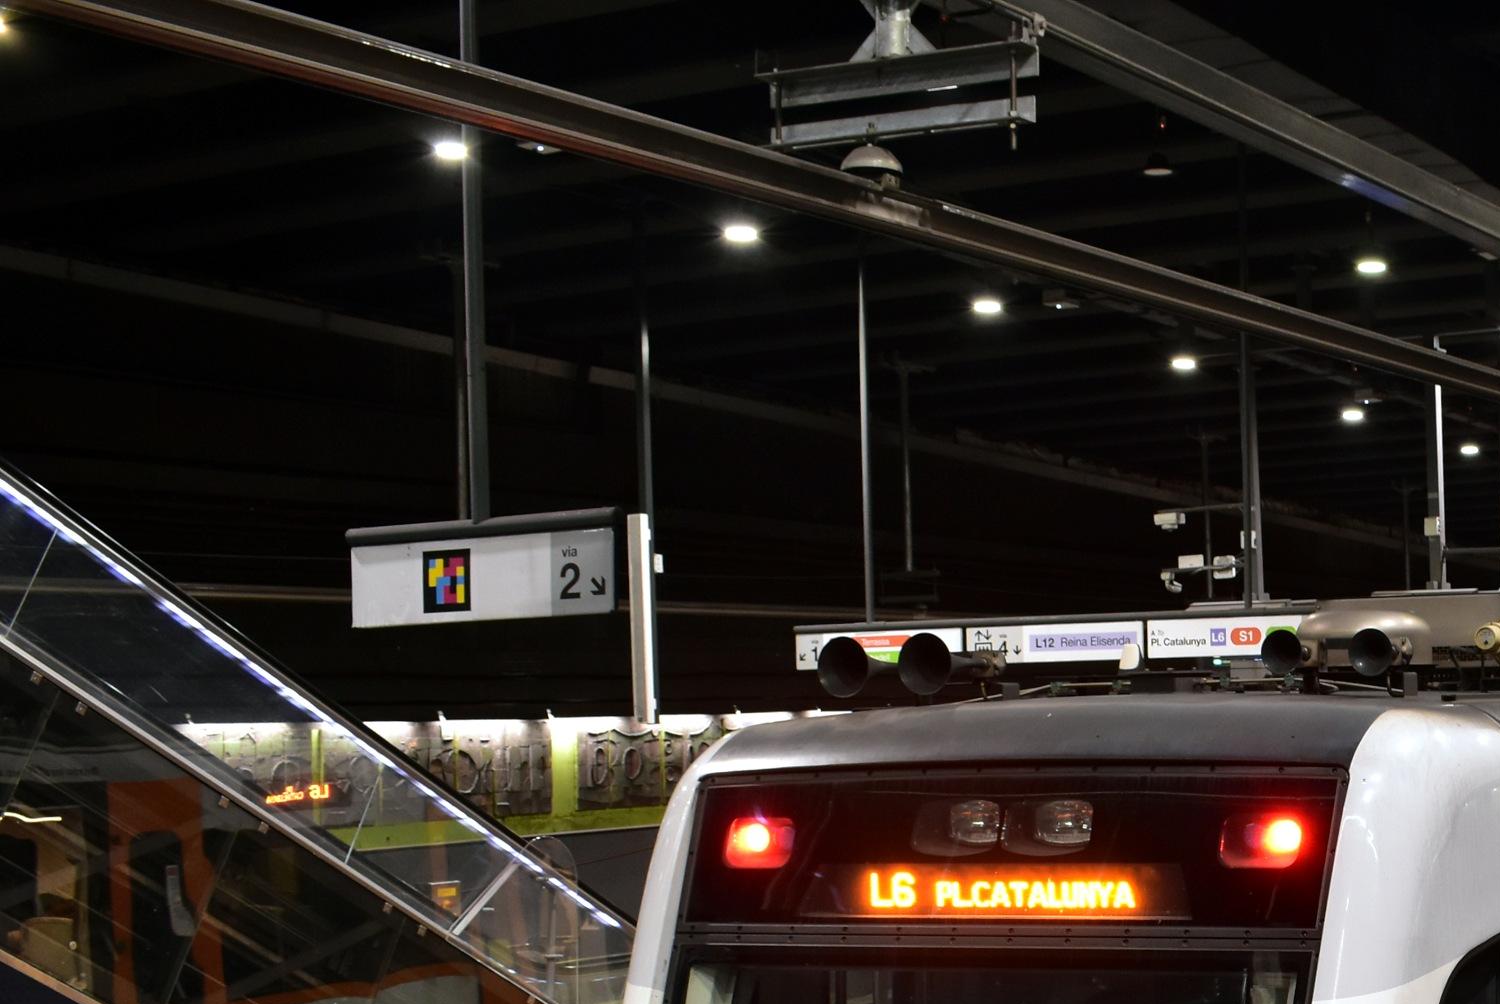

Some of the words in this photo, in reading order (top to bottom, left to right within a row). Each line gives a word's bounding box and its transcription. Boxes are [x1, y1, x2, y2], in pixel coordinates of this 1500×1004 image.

[561, 545, 577, 557] via
[560, 562, 581, 600] 2
[1035, 637, 1055, 649] L12
[1060, 636, 1088, 648] Reina
[1090, 634, 1131, 647] Elisenda
[1163, 636, 1206, 648] Catalunya
[1211, 633, 1225, 643] L6
[1239, 631, 1254, 642] S1
[868, 870, 918, 909] L6
